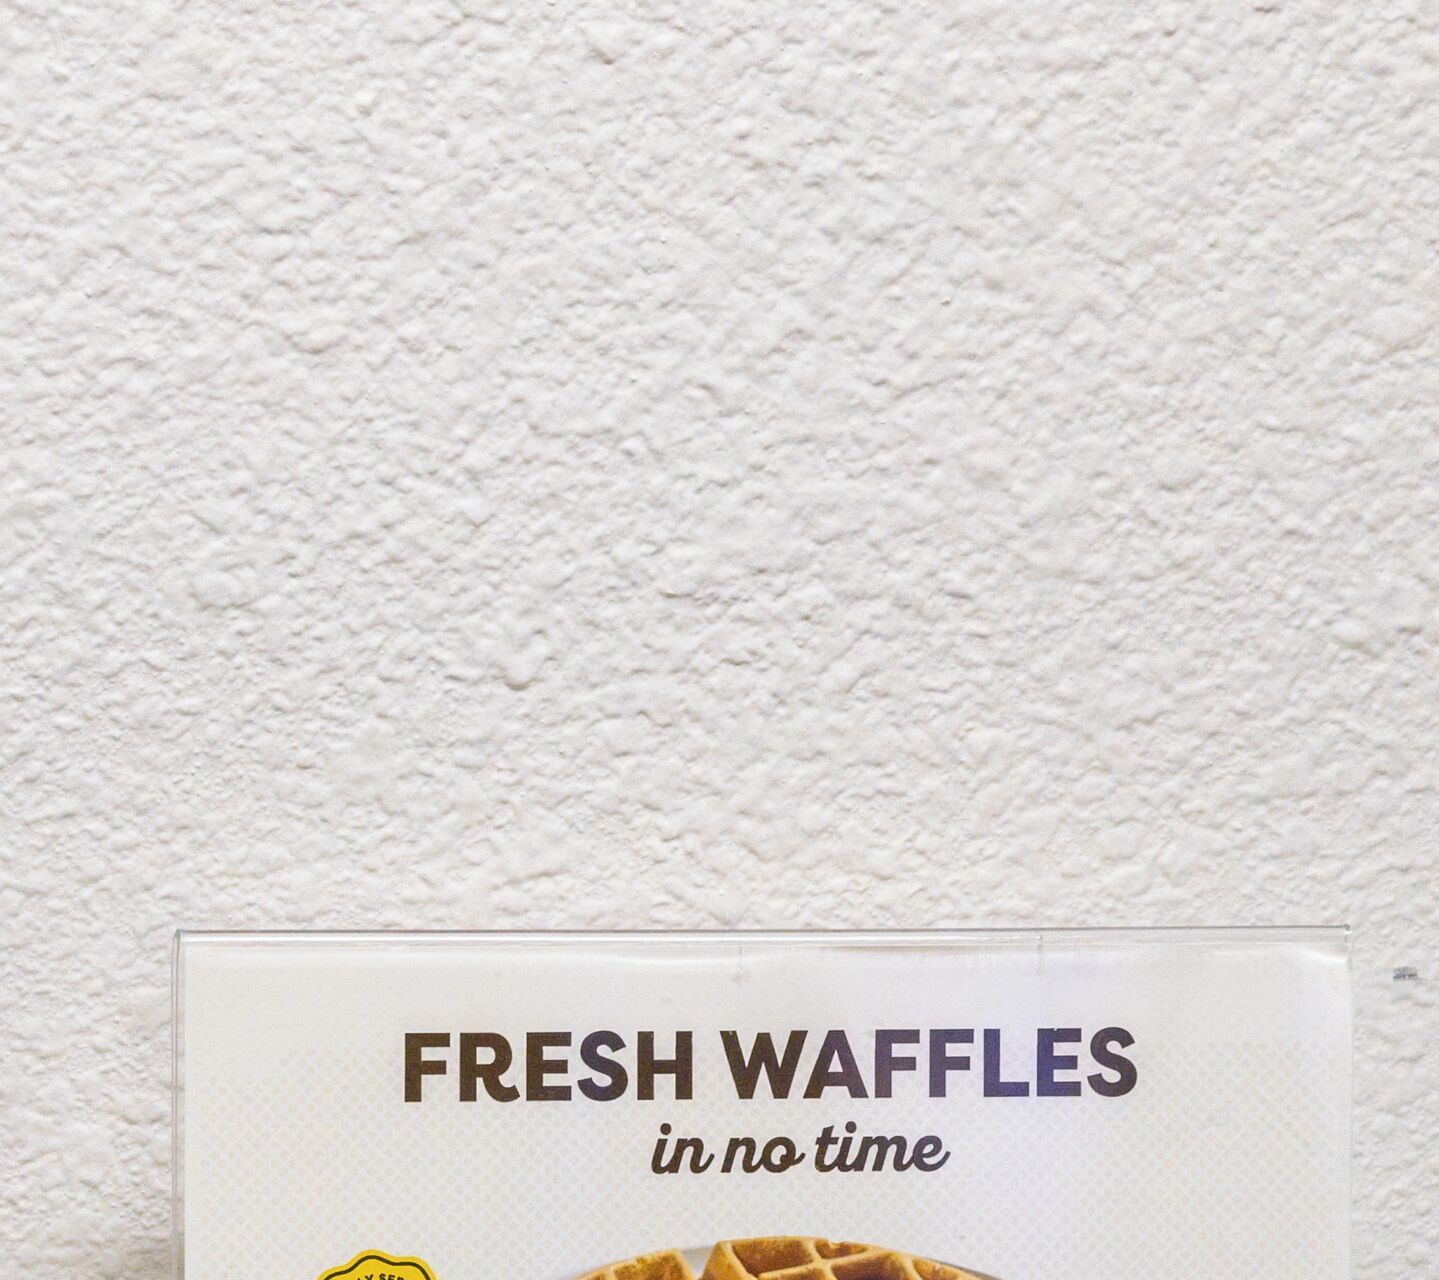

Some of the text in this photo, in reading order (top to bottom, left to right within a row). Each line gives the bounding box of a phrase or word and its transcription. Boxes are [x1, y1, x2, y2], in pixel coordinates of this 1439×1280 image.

[404, 1027, 1138, 1103] FRESH WAFFLES
[651, 1120, 951, 1174] in no time
